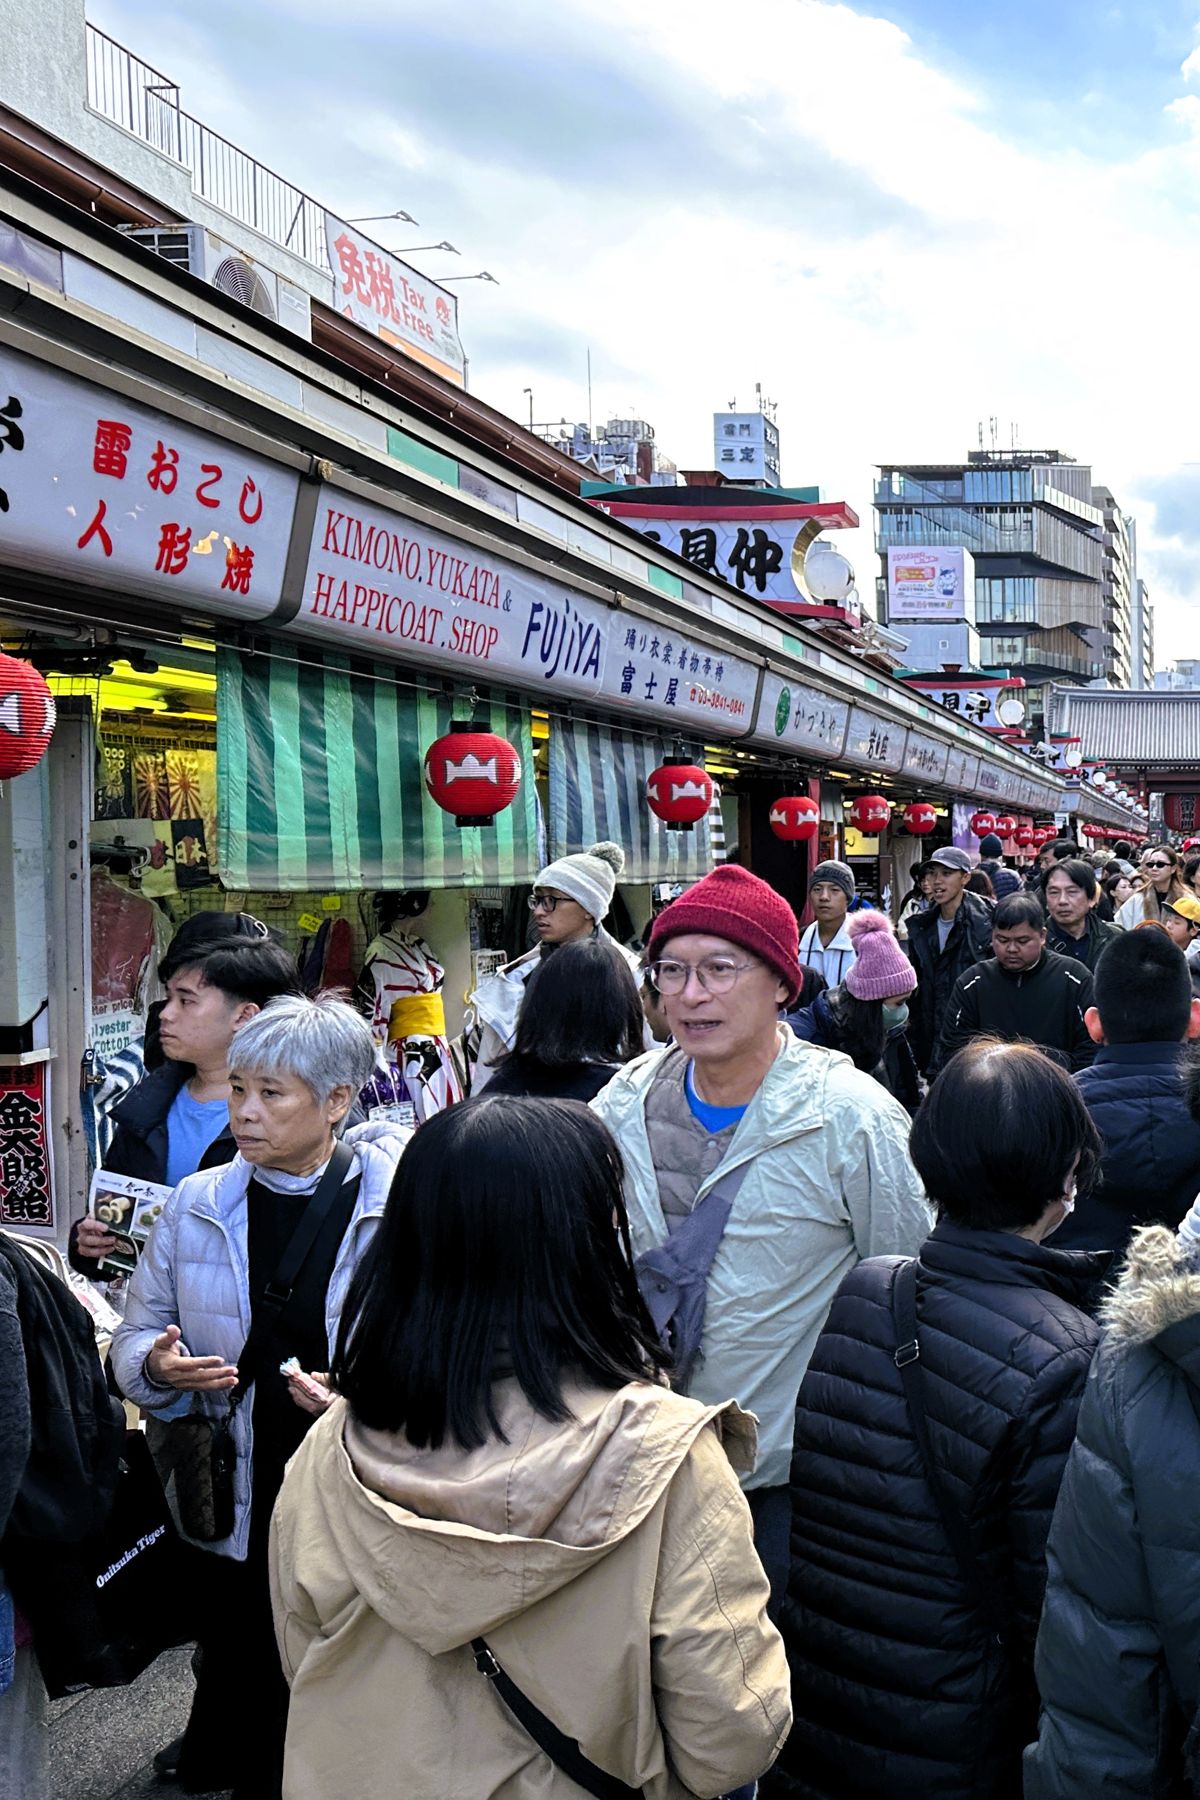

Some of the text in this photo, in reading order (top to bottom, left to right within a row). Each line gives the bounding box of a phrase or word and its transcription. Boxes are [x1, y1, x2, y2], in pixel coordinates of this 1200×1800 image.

[334, 233, 401, 325] 免税
[400, 276, 428, 314] Tax
[402, 302, 434, 342] Free
[93, 419, 263, 524] 雷おこし
[721, 446, 755, 463] 三定
[77, 499, 255, 595] 人形焼
[502, 589, 512, 612] &
[620, 660, 679, 707] 富士屋
[175, 837, 207, 865] 日本
[96, 1524, 167, 1588] Onitsuka Tiger
